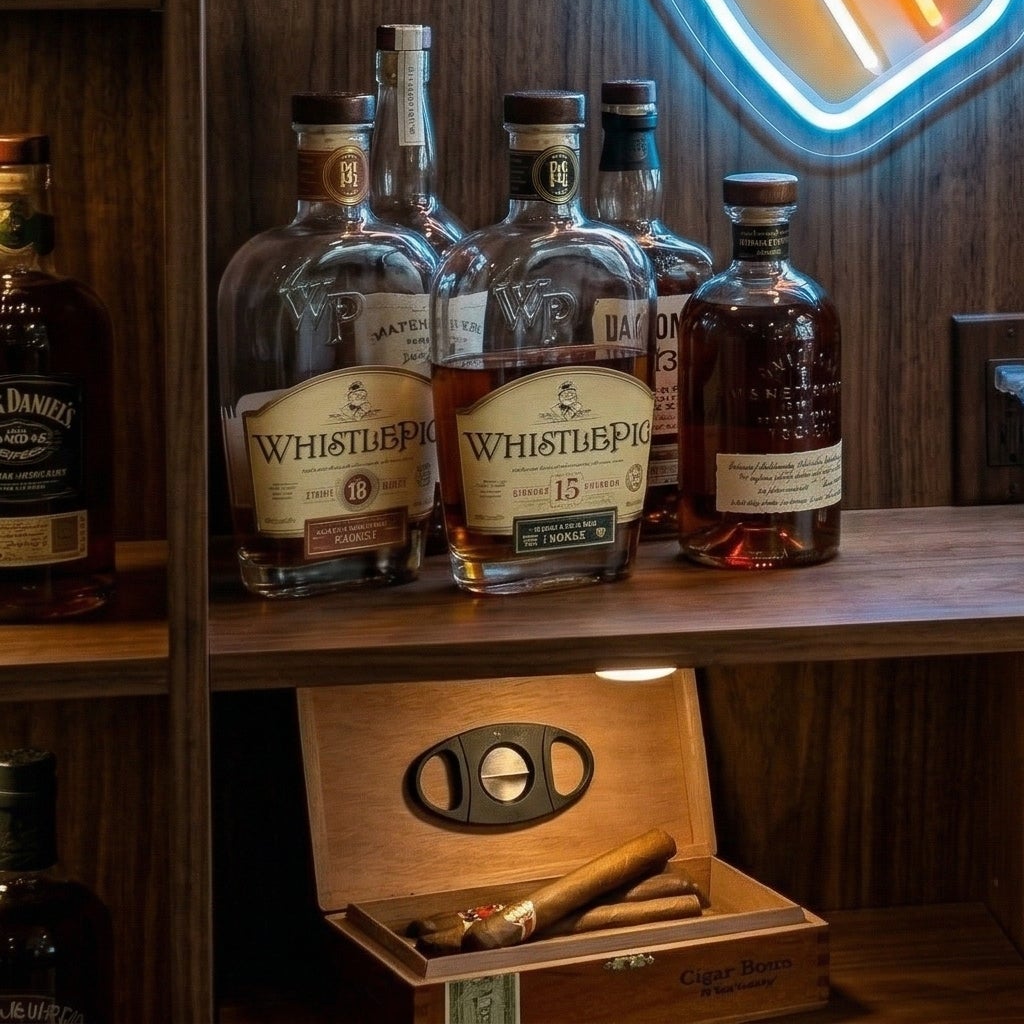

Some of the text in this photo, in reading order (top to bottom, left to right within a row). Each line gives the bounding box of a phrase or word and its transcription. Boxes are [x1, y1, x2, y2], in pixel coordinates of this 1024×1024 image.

[348, 480, 368, 502] 18
[555, 477, 581, 502] 15
[680, 968, 735, 986] Cigar
